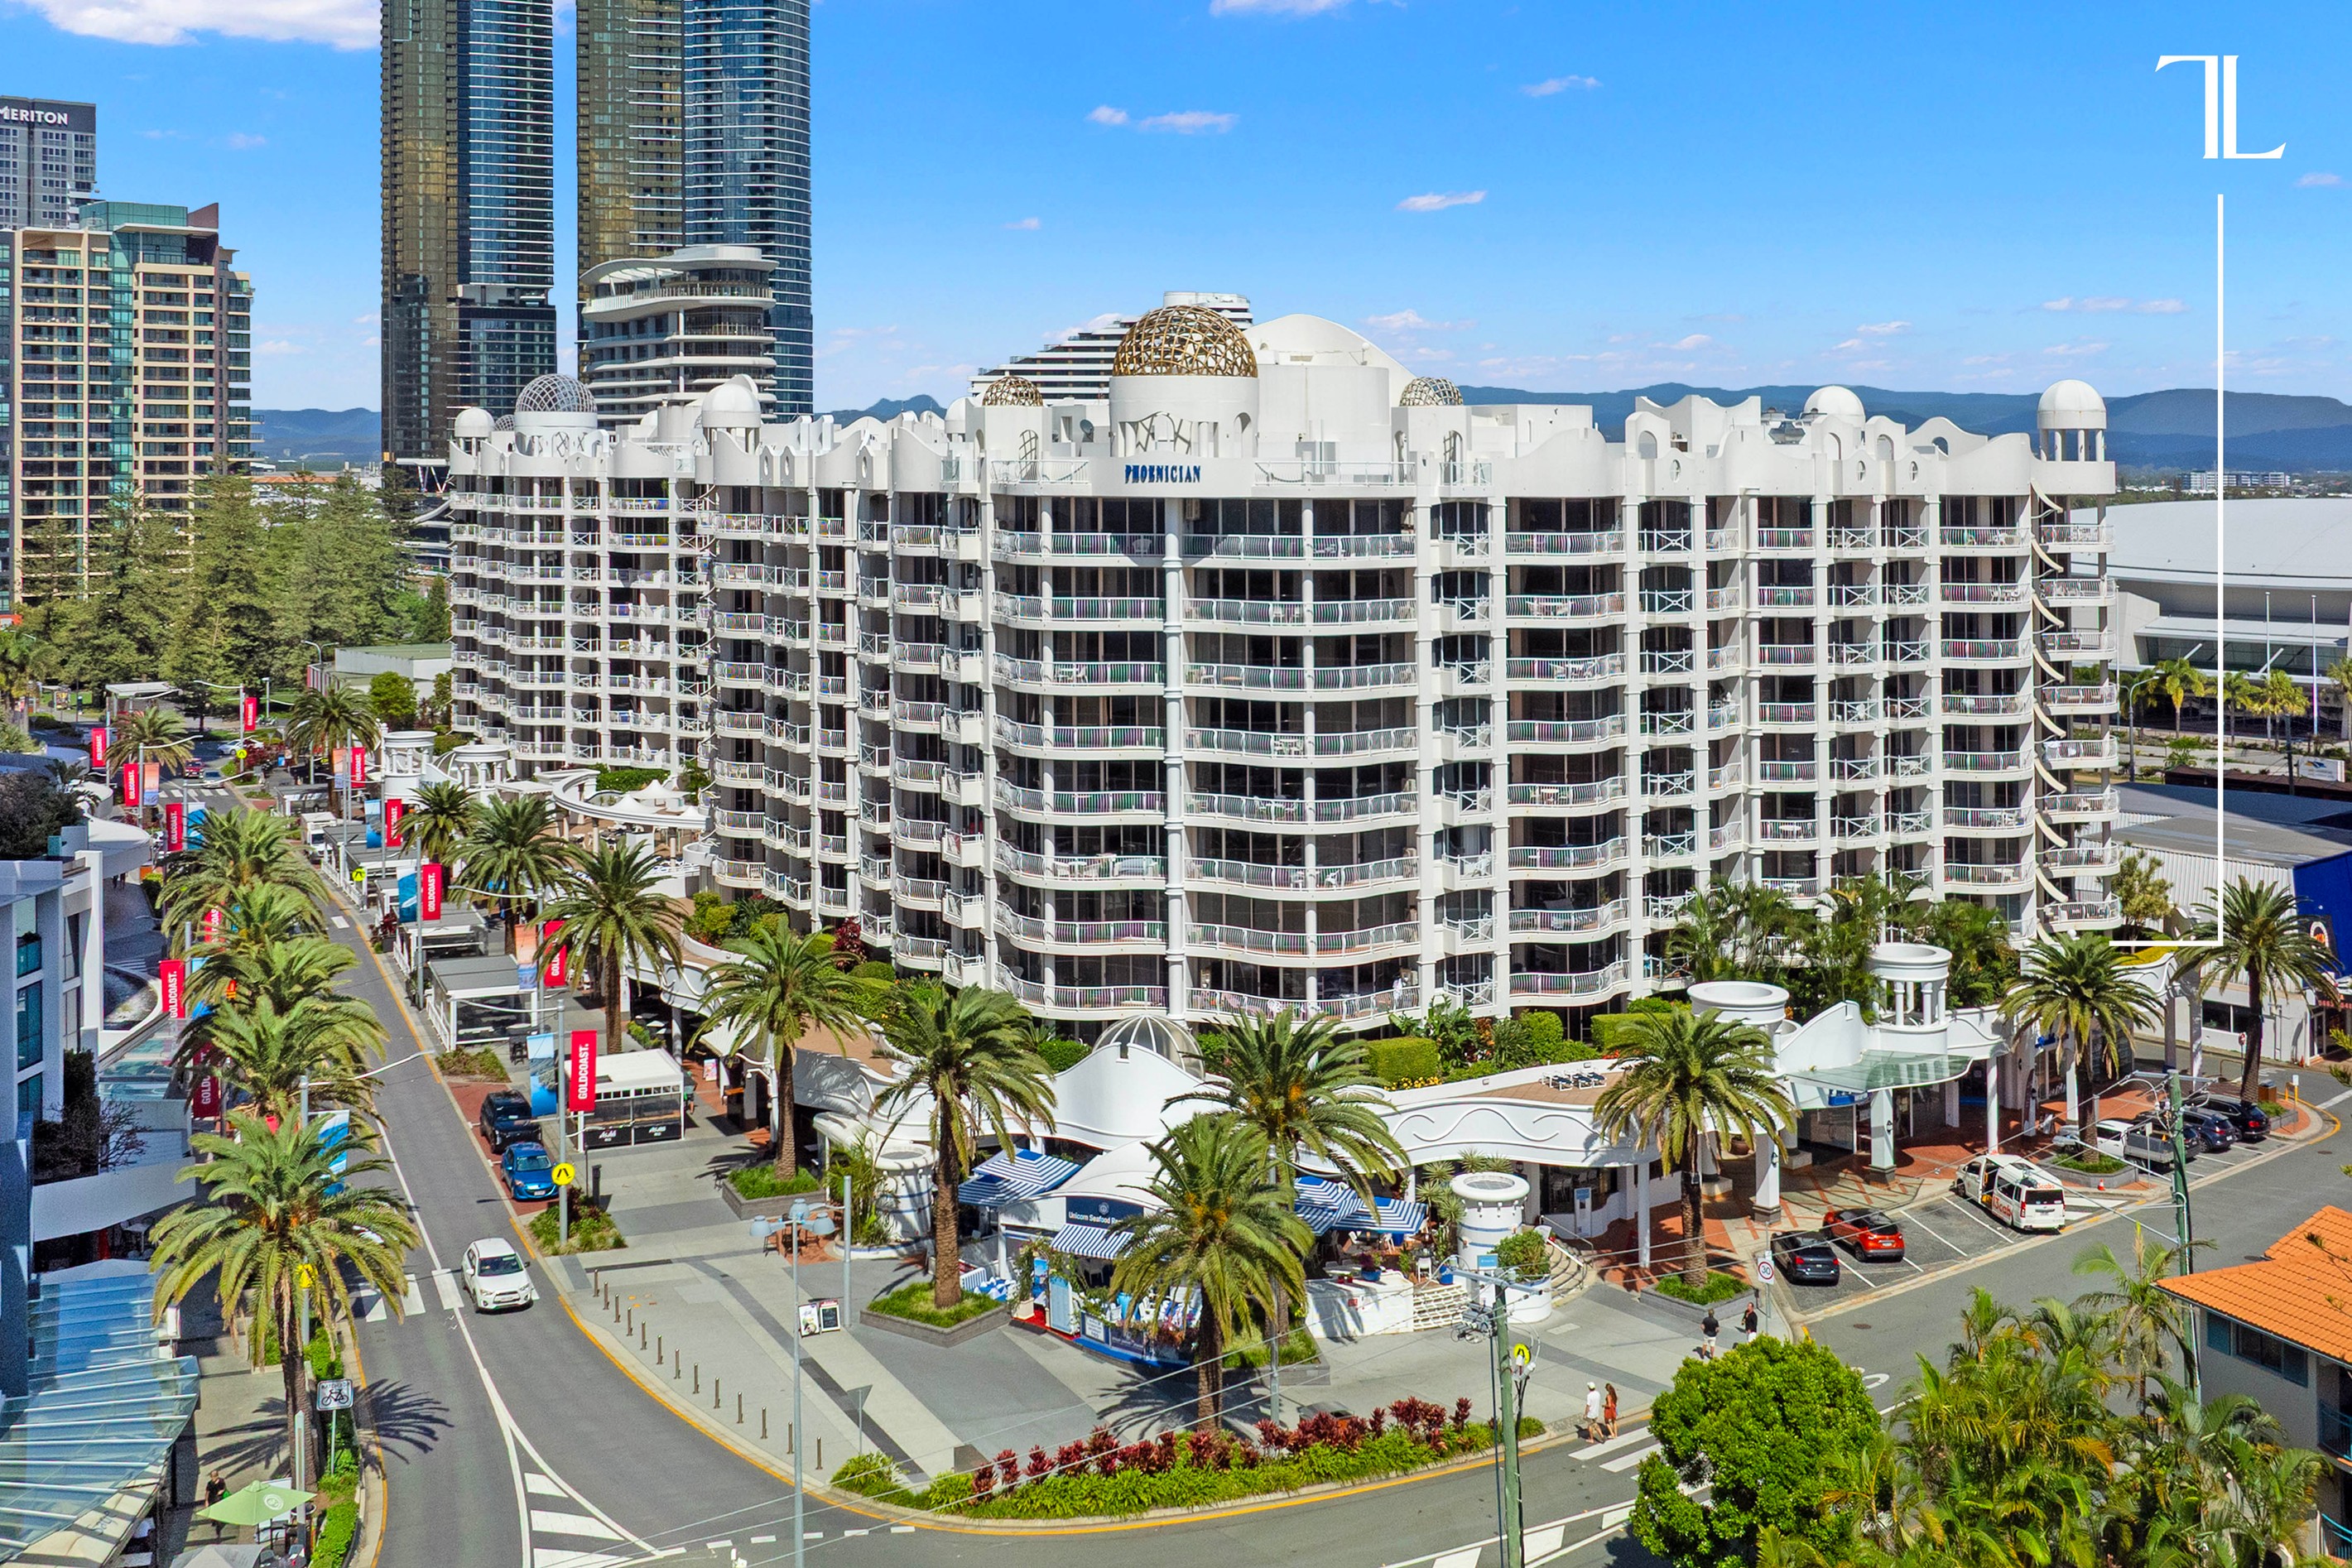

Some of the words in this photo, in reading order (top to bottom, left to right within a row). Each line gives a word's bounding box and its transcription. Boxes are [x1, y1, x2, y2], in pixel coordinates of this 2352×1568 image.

[1125, 464, 1200, 483] PHOENICIAN
[1068, 1211, 1089, 1221] Unicorn
[1762, 1265, 1771, 1275] 30
